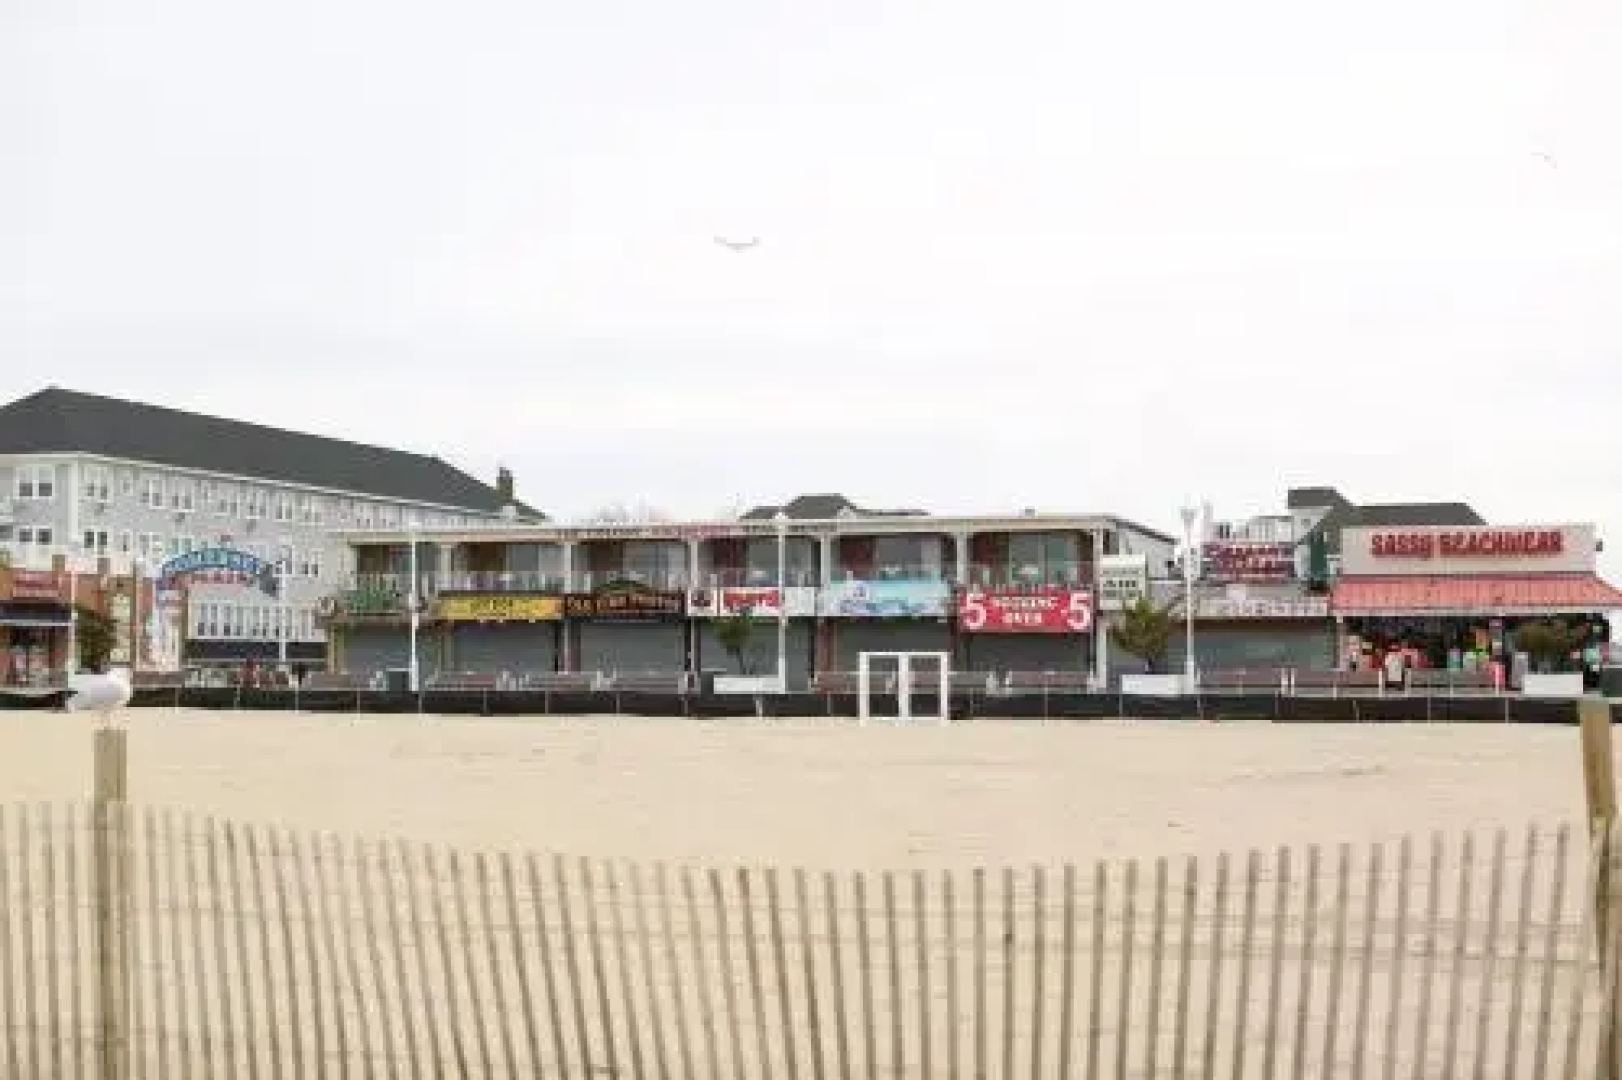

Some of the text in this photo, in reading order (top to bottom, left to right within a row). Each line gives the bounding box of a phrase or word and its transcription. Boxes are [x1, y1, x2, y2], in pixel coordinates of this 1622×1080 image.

[1438, 531, 1563, 557] BEACHWEAR
[964, 592, 987, 630] 5
[1066, 592, 1091, 630] 5
